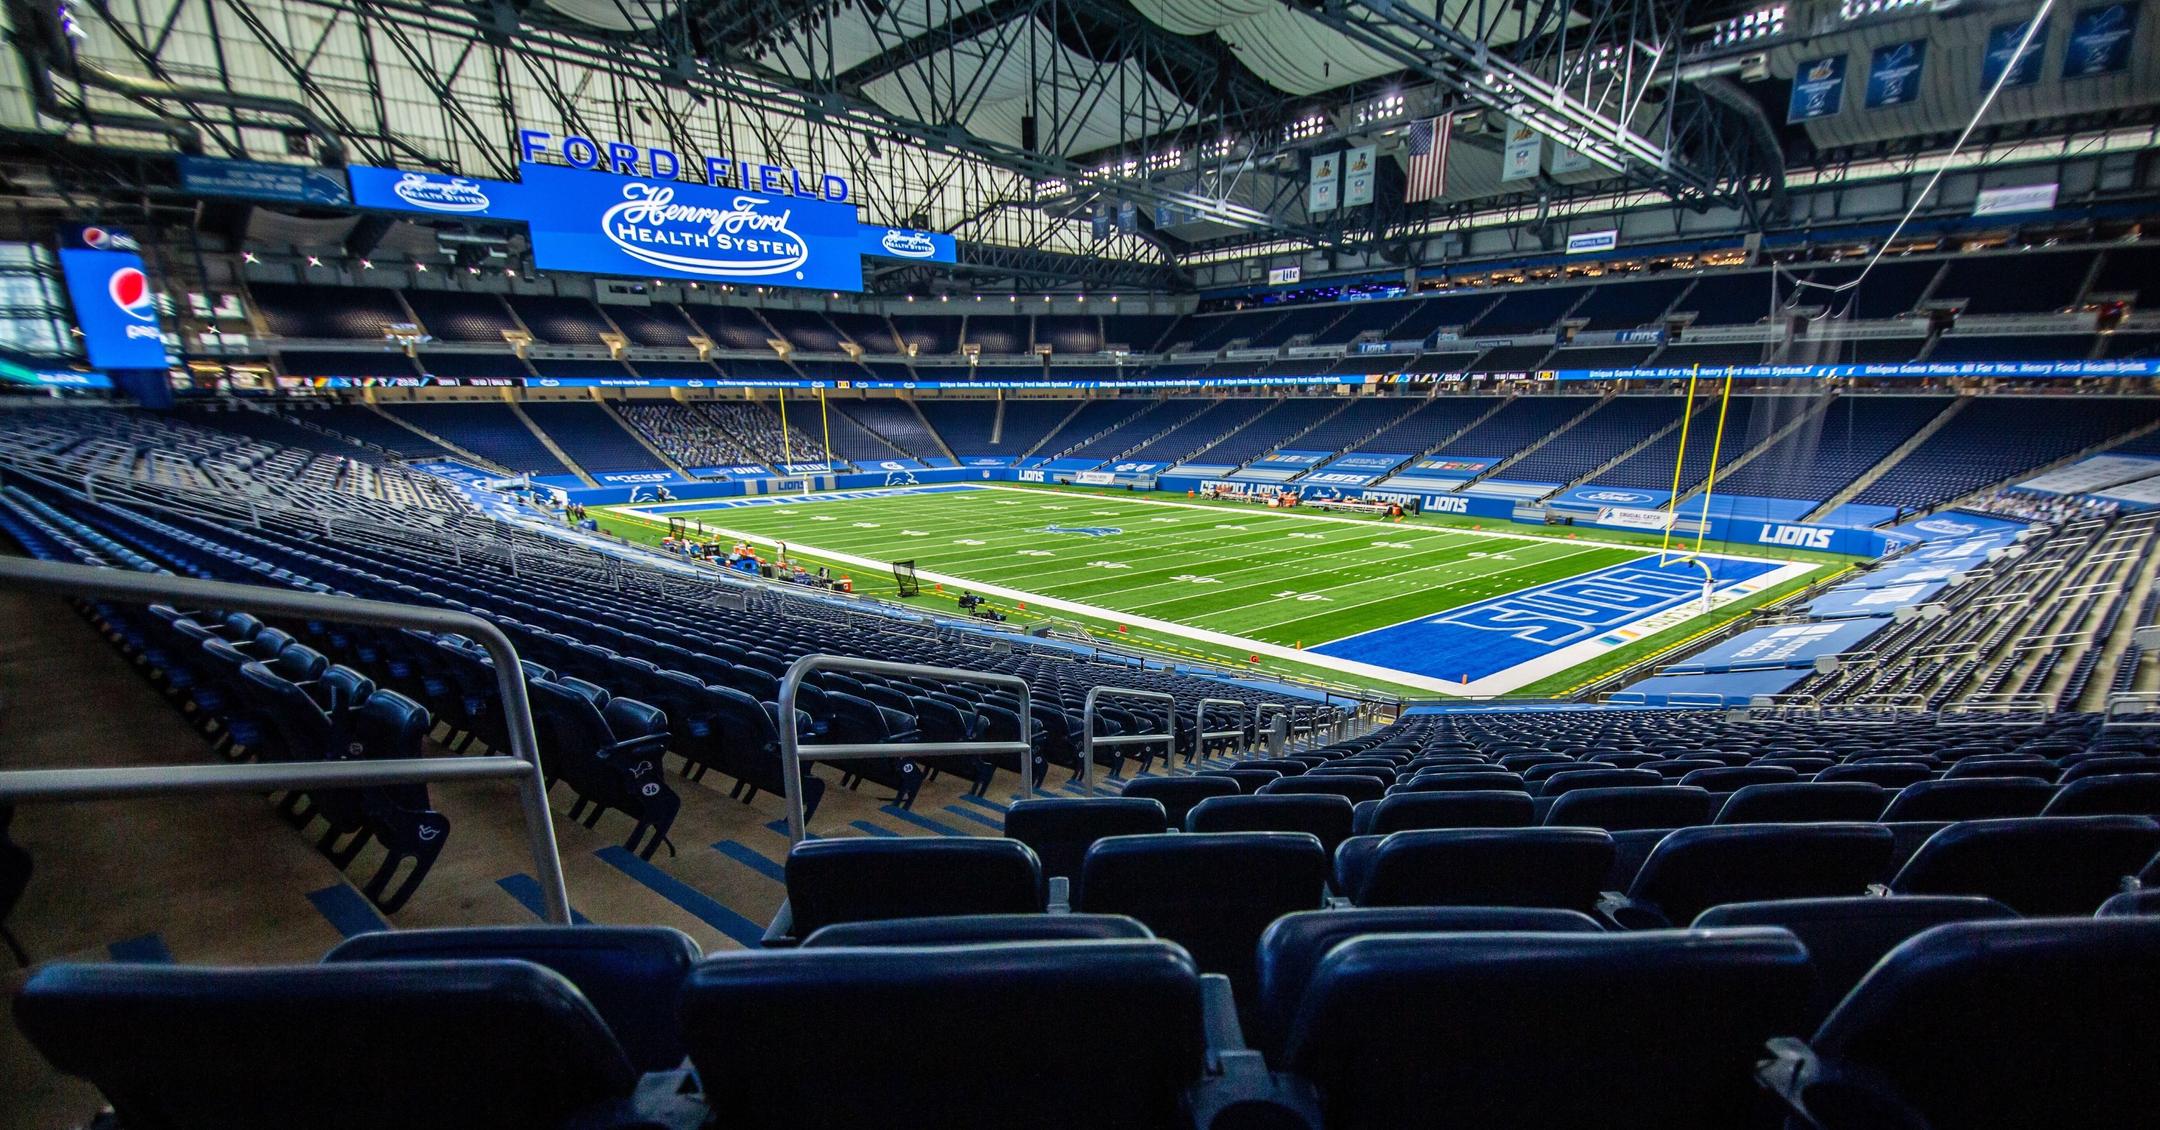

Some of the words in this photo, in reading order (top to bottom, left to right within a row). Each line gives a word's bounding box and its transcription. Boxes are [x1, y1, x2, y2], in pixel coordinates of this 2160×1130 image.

[520, 128, 681, 182] FORD
[707, 156, 849, 203] FIELD
[623, 182, 726, 236] Henry
[724, 195, 791, 234] Ford
[617, 222, 709, 249] HEALTH
[716, 233, 800, 257] SYSTEM
[1589, 370, 1613, 378] Unique
[1614, 369, 1634, 377] Game
[1635, 369, 1656, 377] Plans.
[1700, 368, 1723, 377] Henry
[1743, 367, 1771, 375] Health
[732, 466, 766, 474] ONE
[1018, 469, 1045, 482] LIONS
[1307, 472, 1371, 483] LIONS
[1424, 495, 1469, 513] LIONS
[1759, 523, 1838, 549] LIONS
